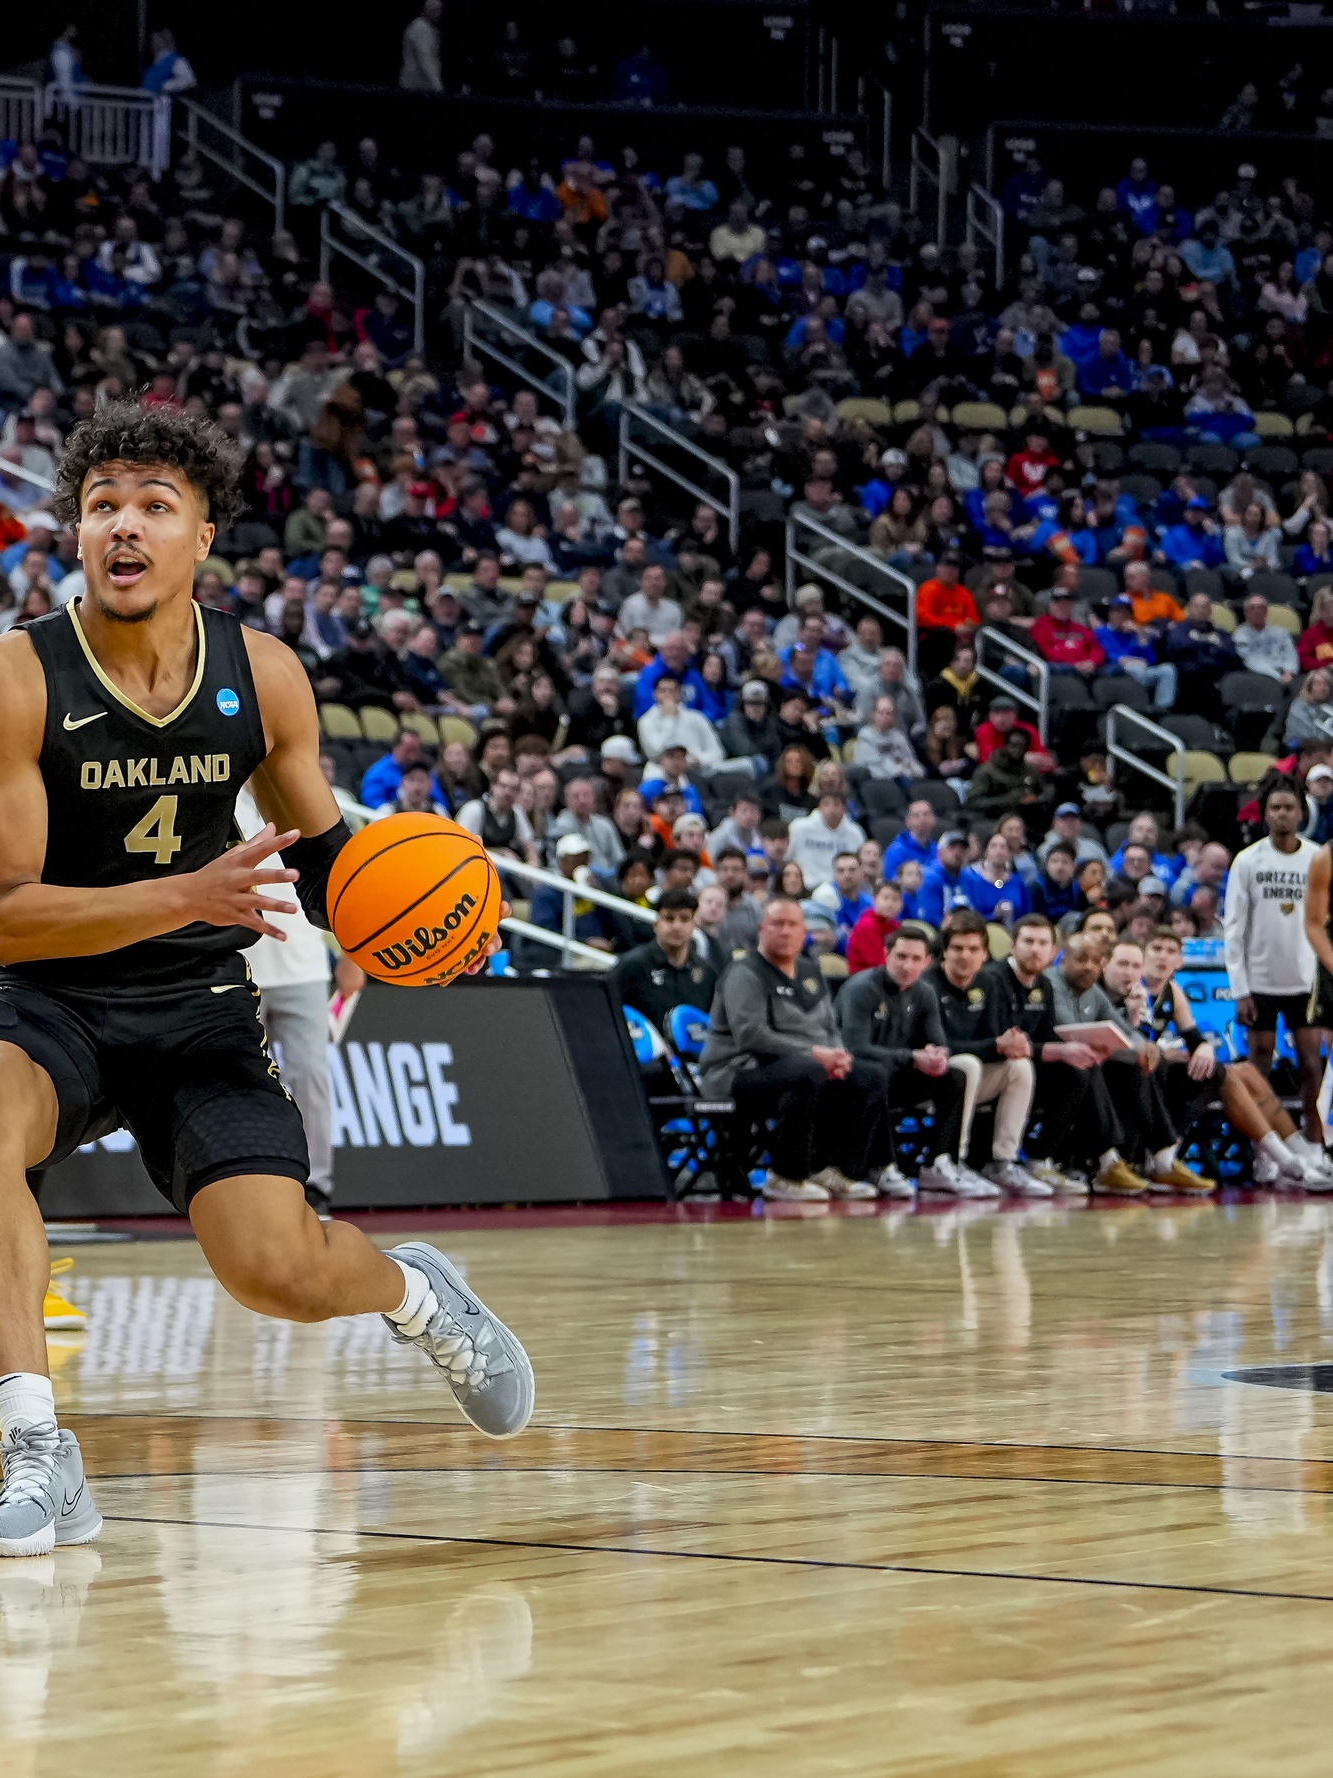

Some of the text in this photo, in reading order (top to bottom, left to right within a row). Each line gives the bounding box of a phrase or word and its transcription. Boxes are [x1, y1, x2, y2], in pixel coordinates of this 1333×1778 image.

[219, 700, 239, 710] NCAA
[80, 753, 231, 790] OAKLAND
[123, 795, 182, 864] 4
[1262, 886, 1303, 900] ENERG
[371, 893, 477, 970] Wilson
[269, 1041, 472, 1147] ANGE
